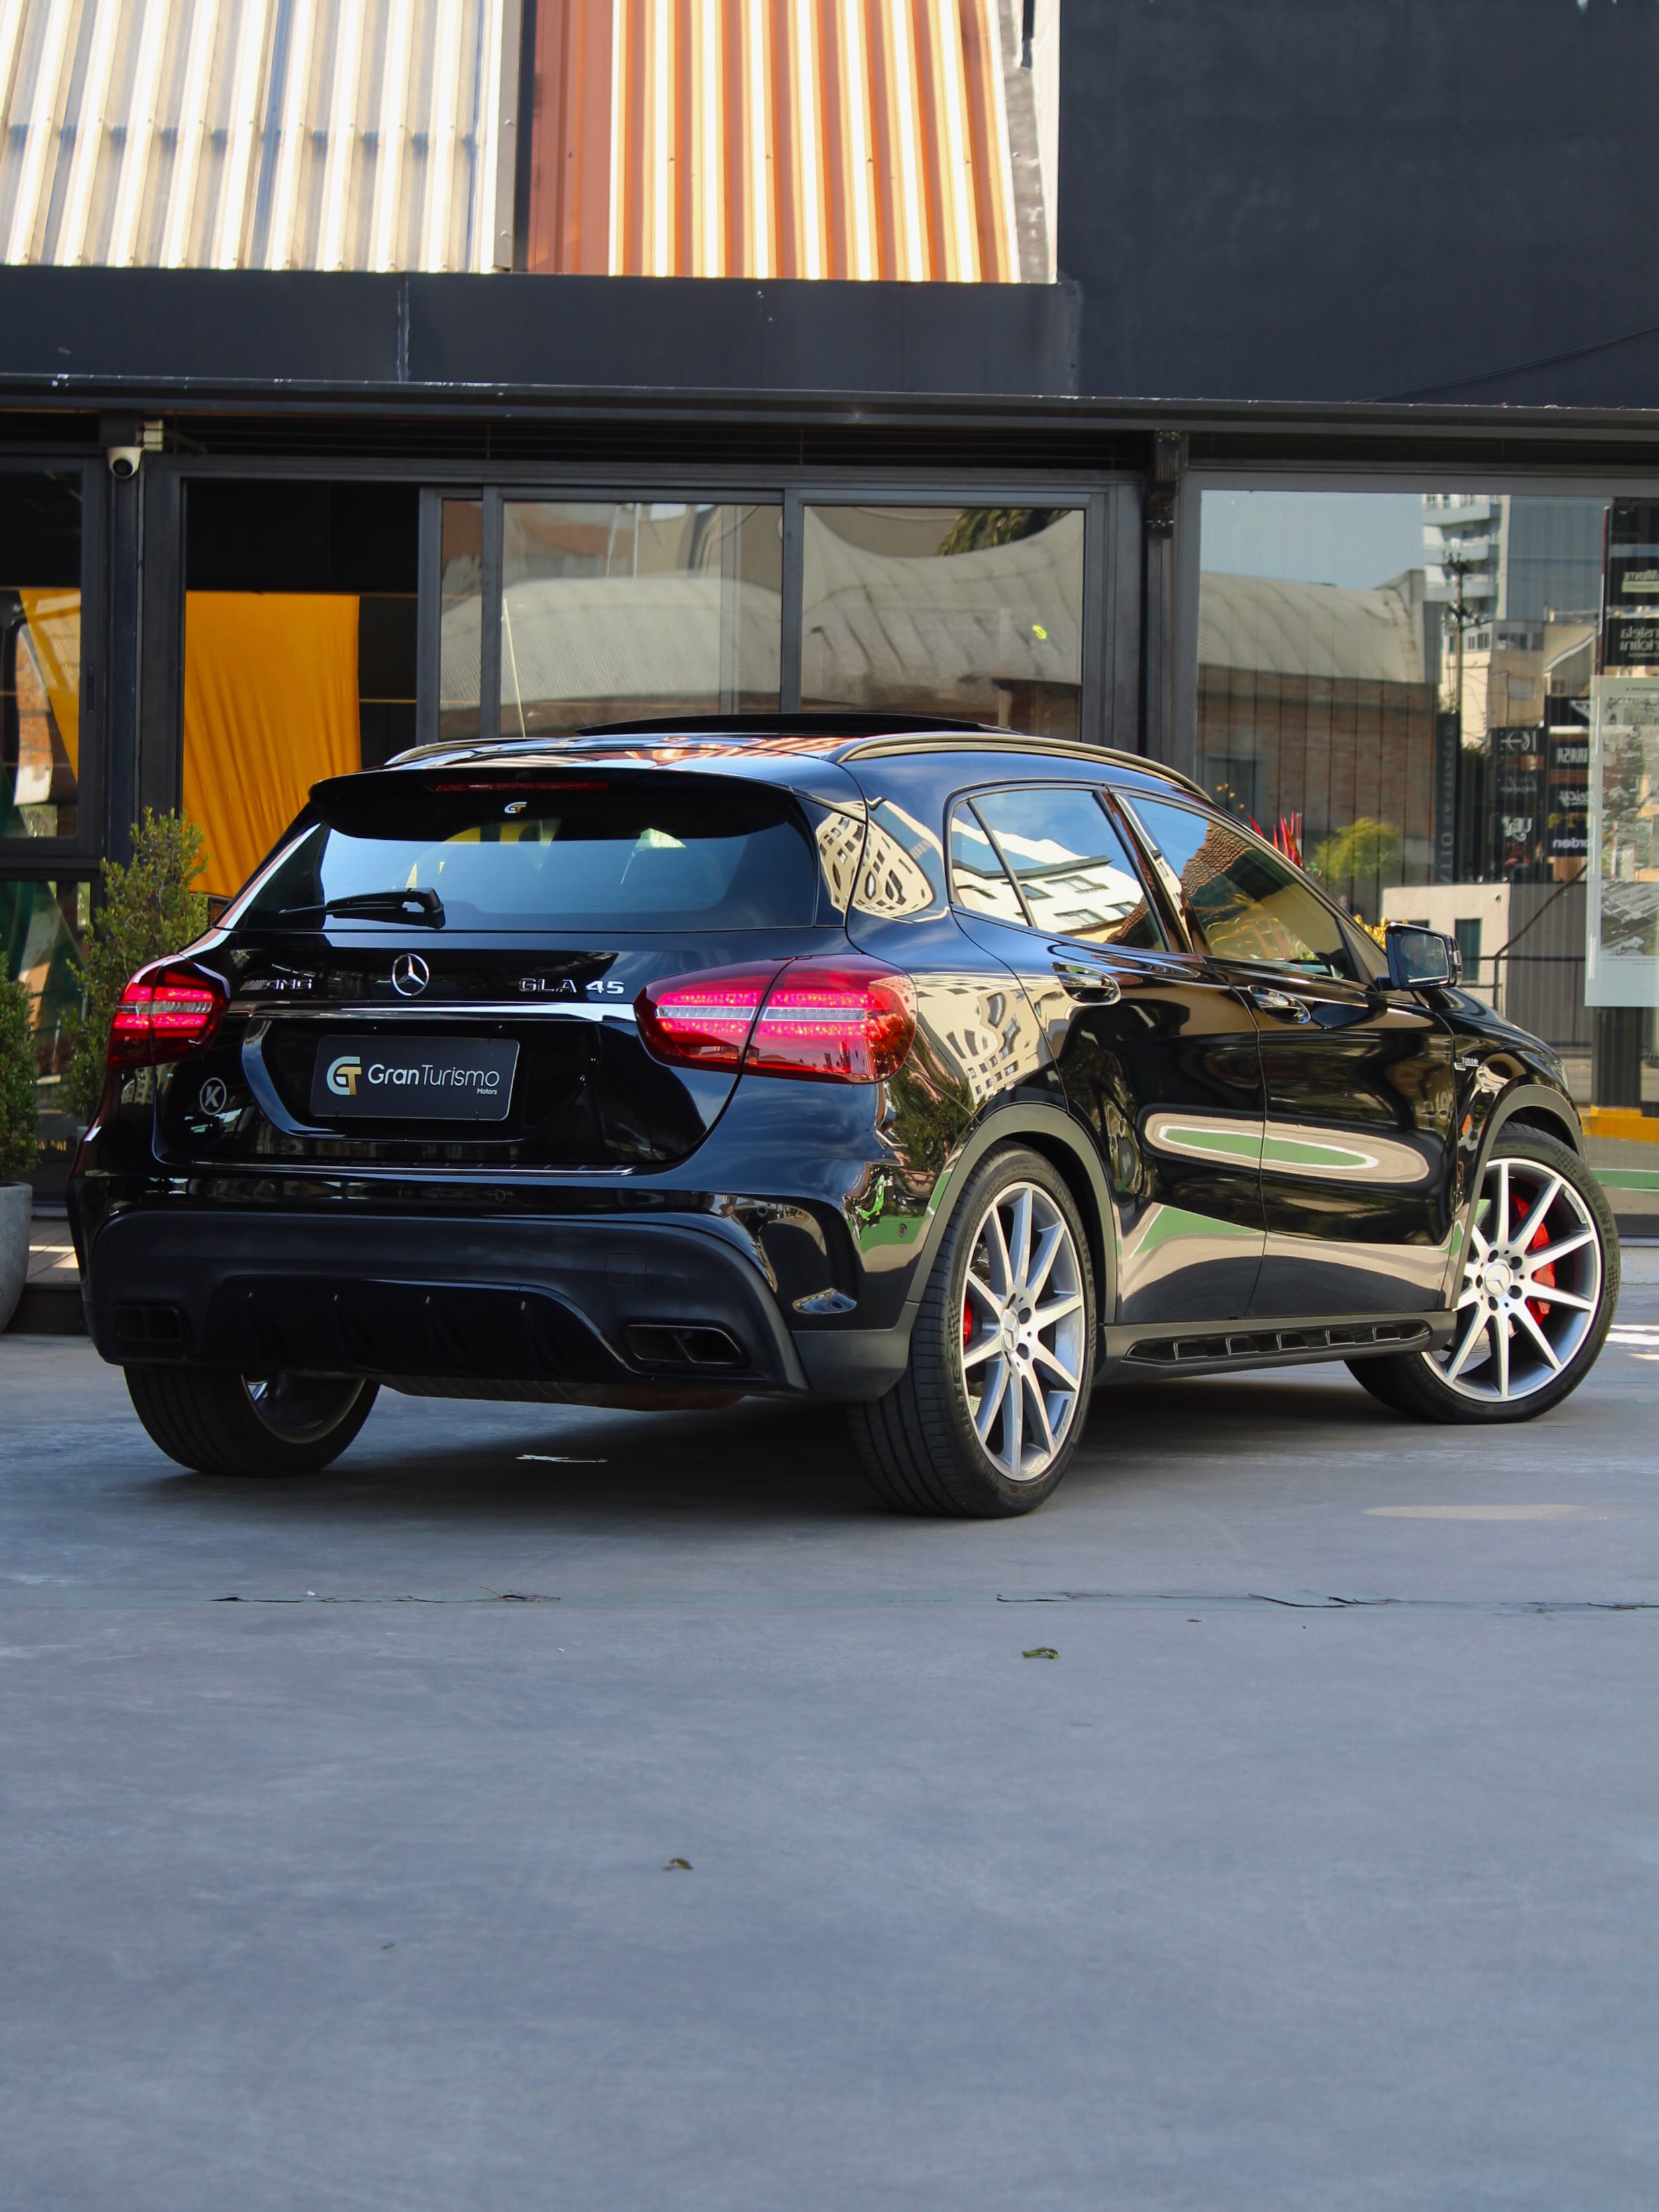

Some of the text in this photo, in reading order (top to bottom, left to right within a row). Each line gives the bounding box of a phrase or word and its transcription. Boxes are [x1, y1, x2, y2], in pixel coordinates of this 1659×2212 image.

[264, 978, 313, 990] AMG
[519, 978, 625, 994] GLA 45
[205, 1086, 221, 1107] K
[1578, 1176, 1617, 1250] DELINTE
